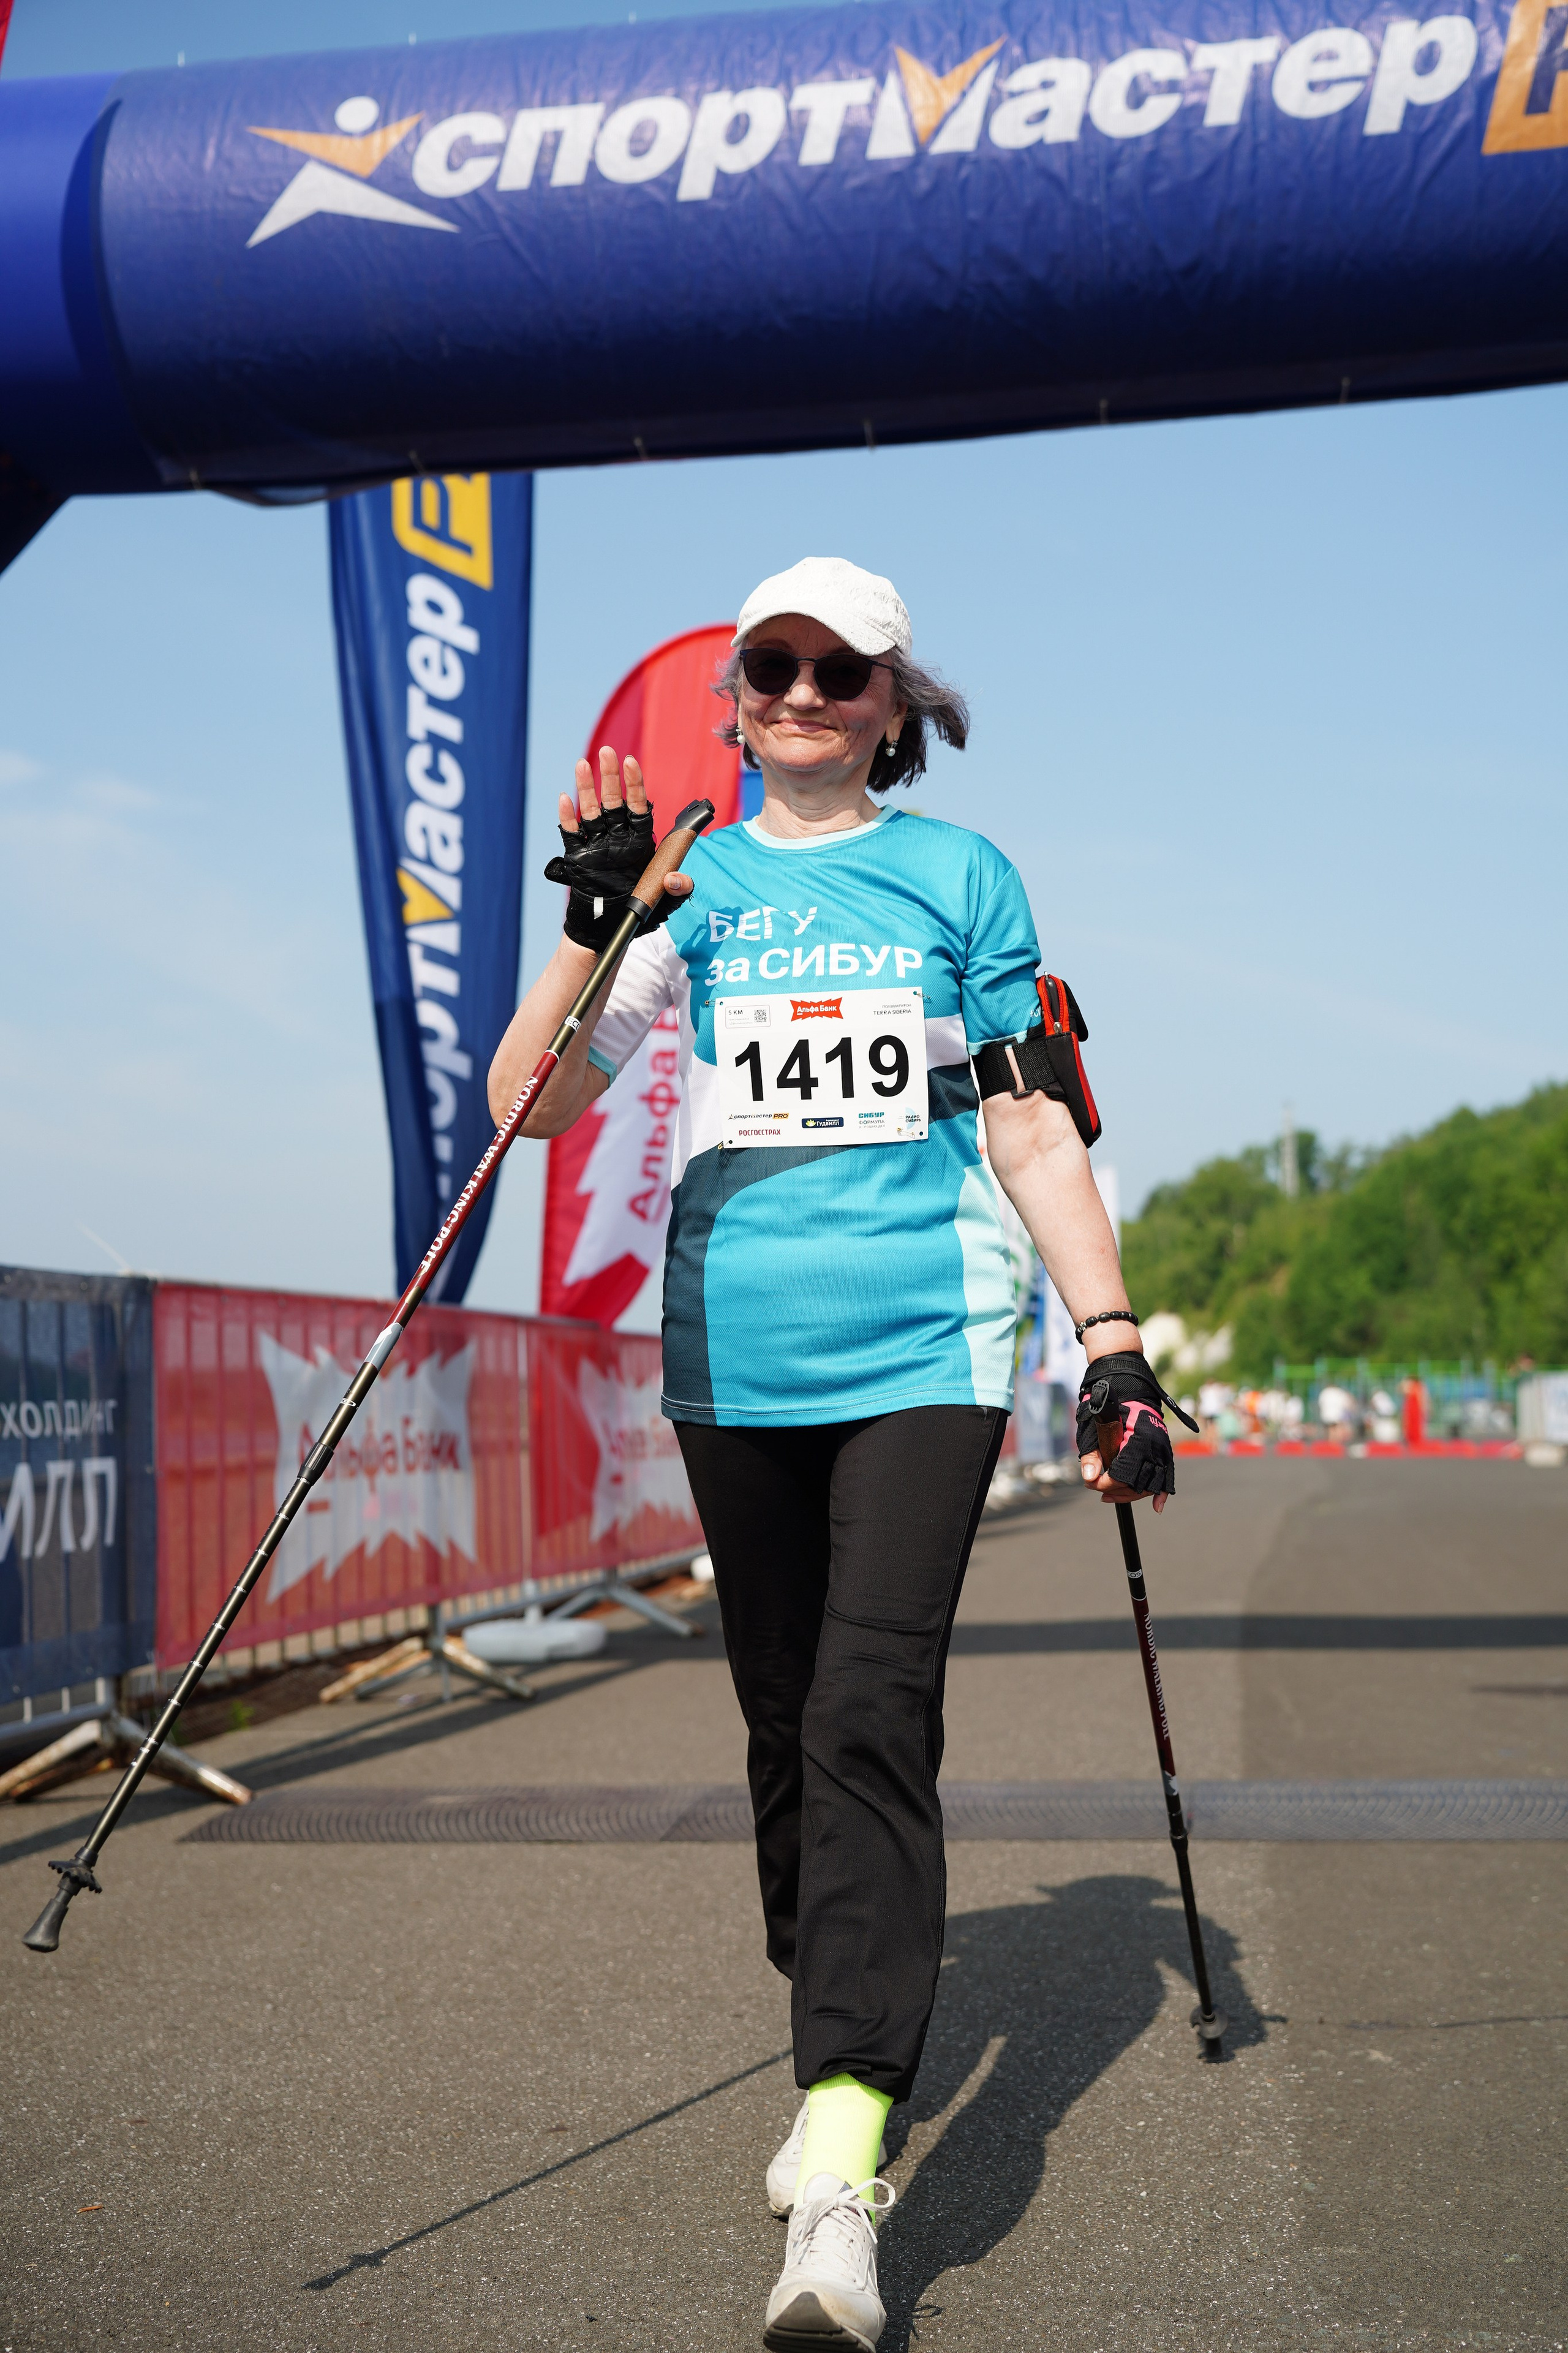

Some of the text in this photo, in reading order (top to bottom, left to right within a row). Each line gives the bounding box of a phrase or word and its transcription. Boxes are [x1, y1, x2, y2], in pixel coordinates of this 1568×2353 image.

[709, 906, 818, 943] БЕГУ
[758, 943, 923, 980] СИБУР
[734, 1035, 910, 1101] 1419
[494, 1076, 539, 1143] NORDIC
[628, 1049, 680, 1221] Альфа
